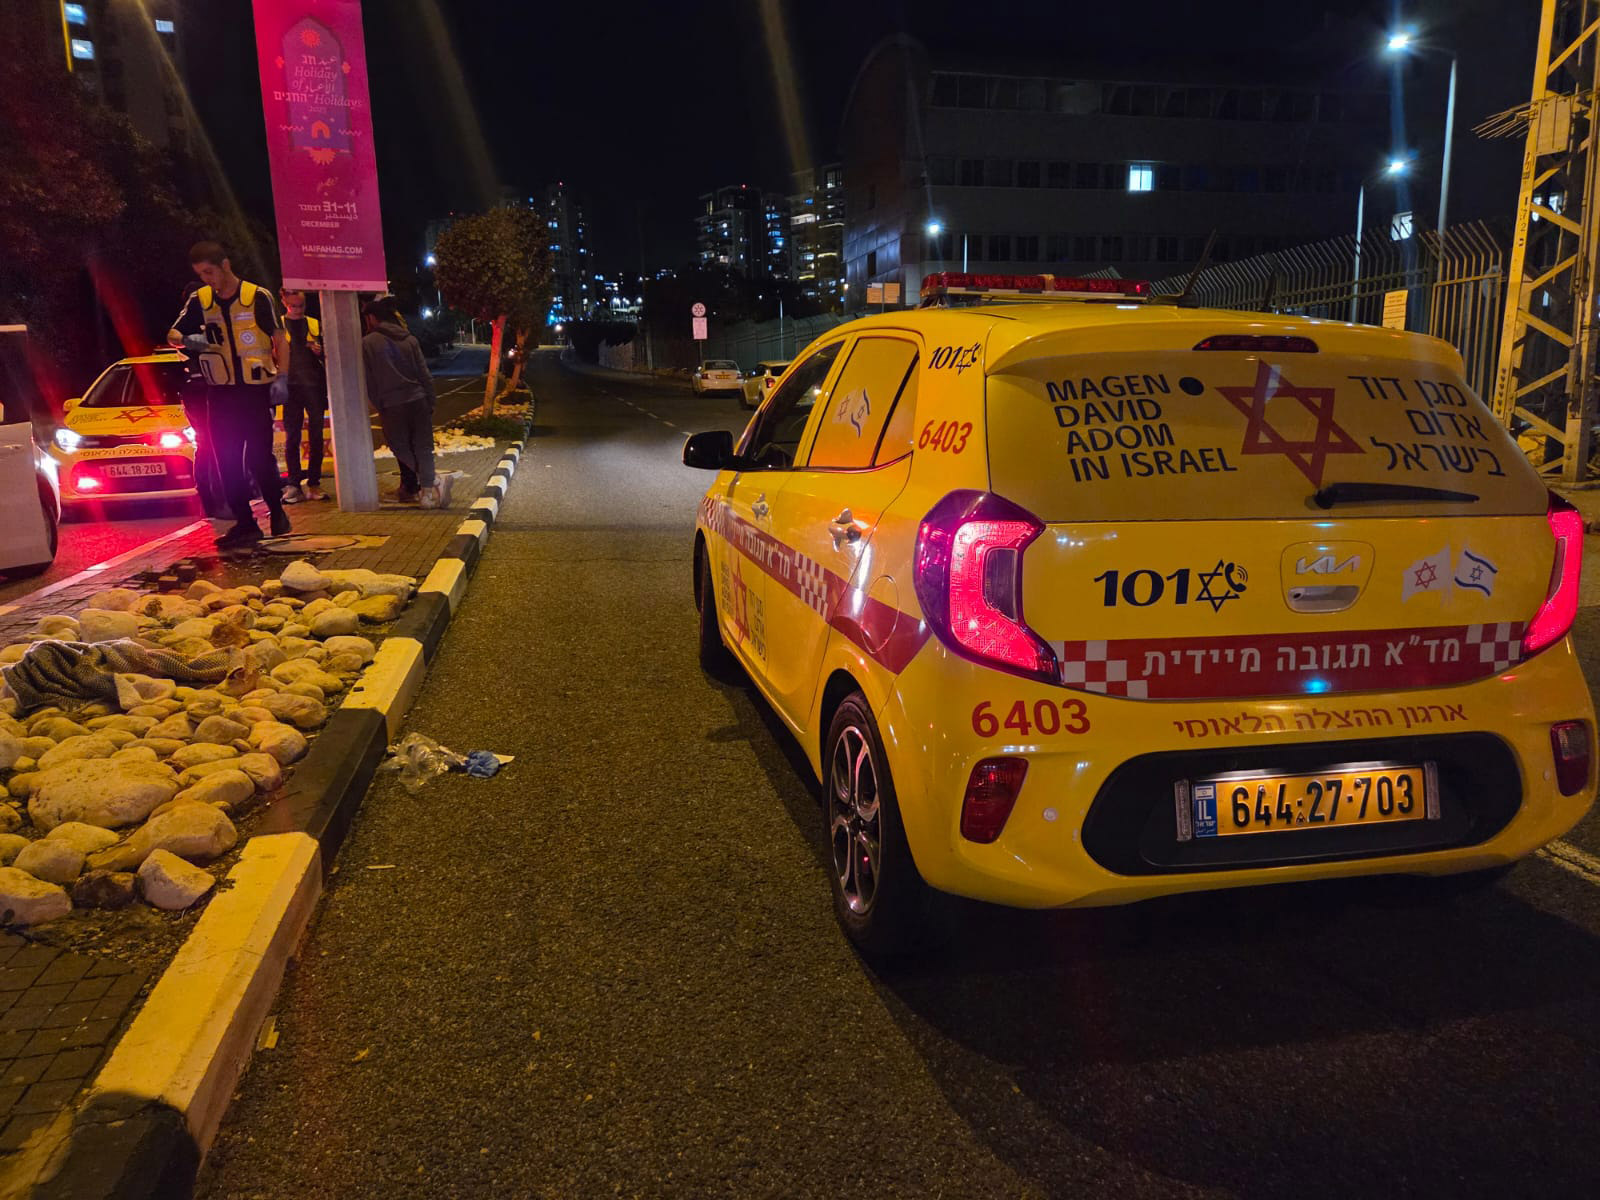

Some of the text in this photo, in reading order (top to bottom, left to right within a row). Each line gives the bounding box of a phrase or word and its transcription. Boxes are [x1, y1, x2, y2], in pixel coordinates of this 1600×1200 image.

[295, 66, 338, 82] Holiday
[273, 90, 307, 102] החגים
[301, 220, 340, 229] DECEMBER
[301, 244, 363, 255] HAIFAHAG.COM
[928, 346, 963, 369] 101
[1046, 374, 1171, 402] MAGEN
[1348, 375, 1467, 408] מגן דוד
[1054, 398, 1162, 428] DAVID
[1406, 409, 1489, 442] אדום
[919, 420, 973, 455] 6403
[1067, 423, 1175, 454] ADOM
[1070, 448, 1238, 482] IN ISRAEL
[1370, 436, 1506, 477] בישראל
[1094, 569, 1190, 607] 101
[1142, 648, 1261, 676] מיידית
[1276, 643, 1371, 671] תגובה
[972, 699, 1091, 738] 6403
[1173, 704, 1468, 738] ארגון ההצלה הלאומי
[1198, 800, 1212, 820] IL
